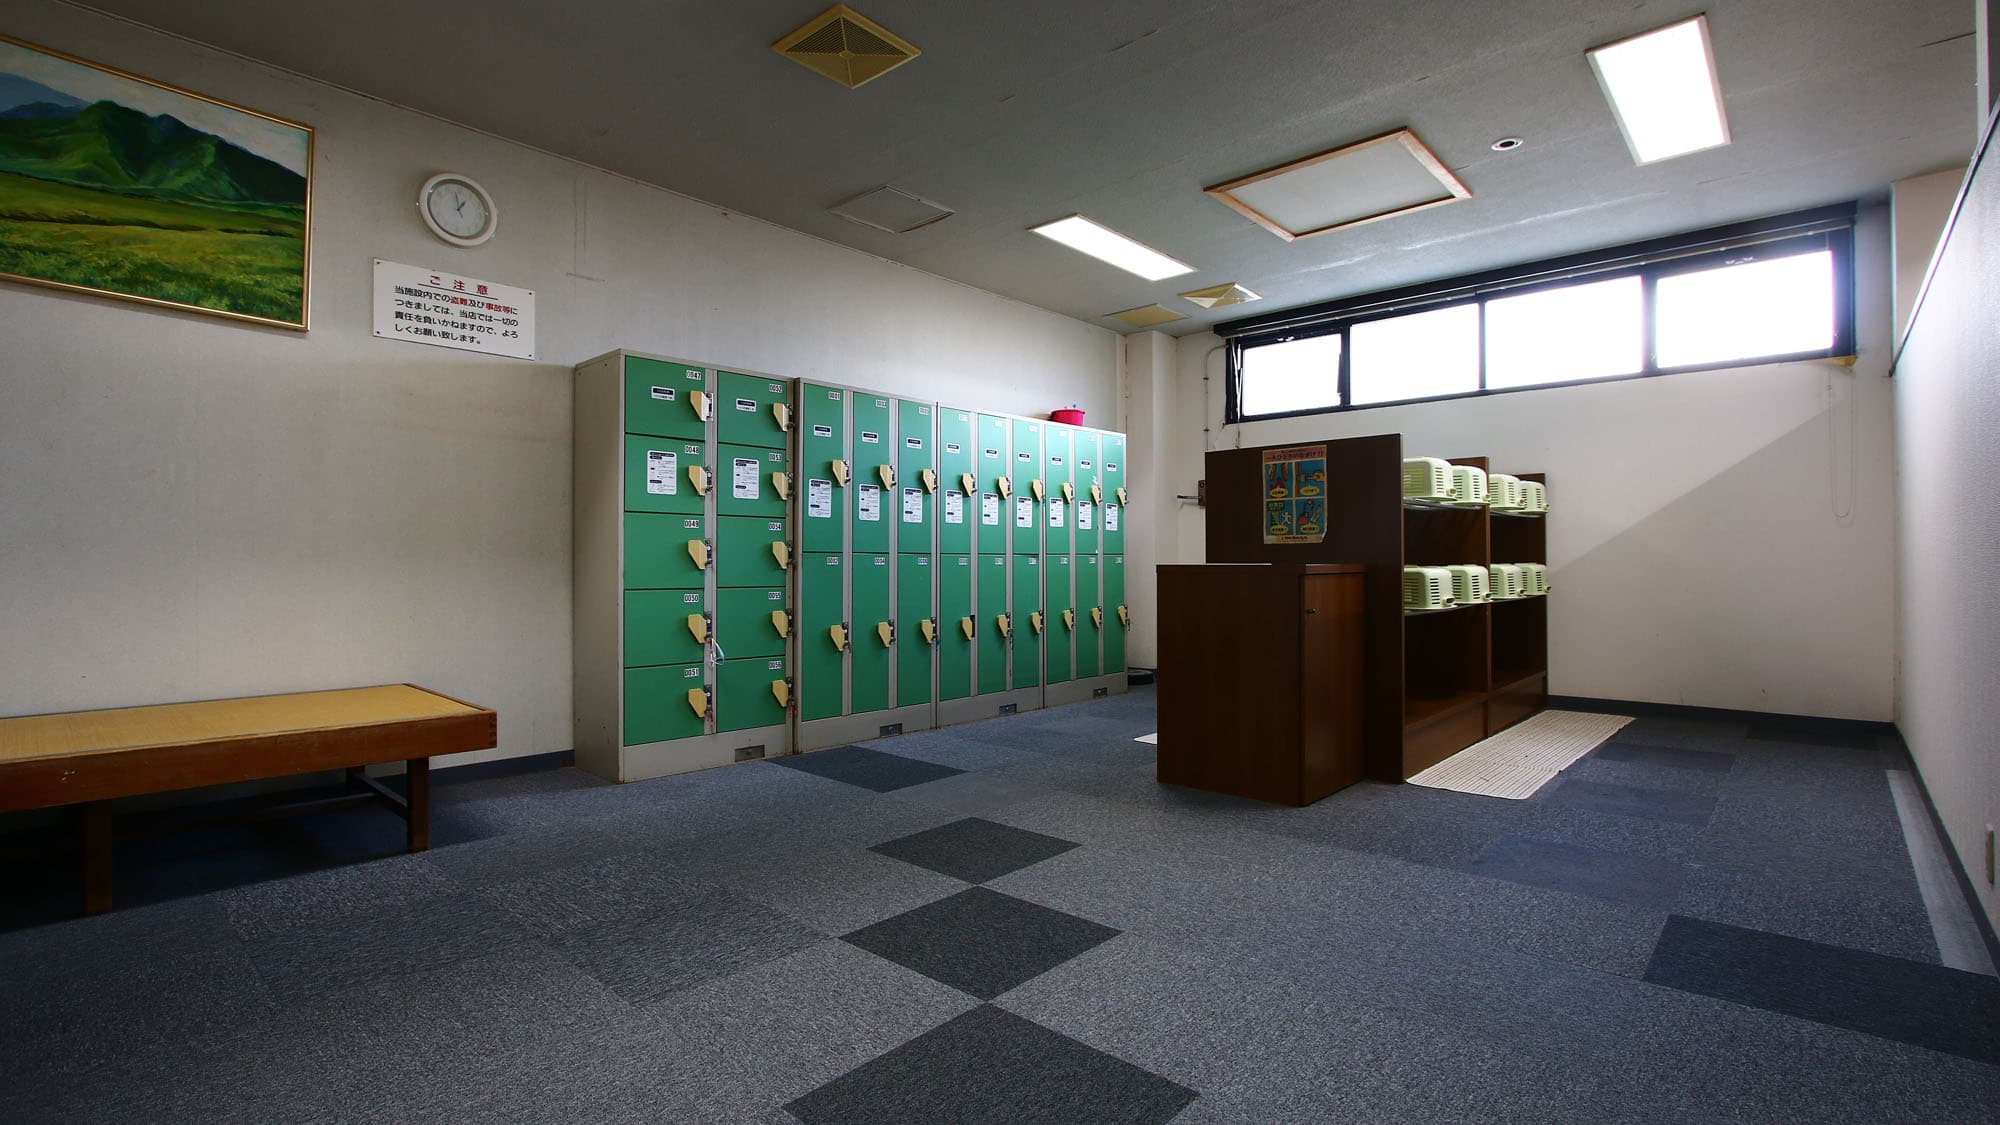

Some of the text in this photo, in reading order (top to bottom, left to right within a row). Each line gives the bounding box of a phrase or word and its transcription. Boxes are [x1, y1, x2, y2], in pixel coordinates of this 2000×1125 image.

[395, 285, 518, 315] 当施設内での盗難及び事故等に
[395, 299, 519, 327] つきましては、当店では一切の
[395, 311, 518, 339] 責任を負いかねますので、よろ
[395, 323, 481, 345] しくお願い致します。
[684, 520, 699, 528] 0049
[684, 594, 699, 602] 0050
